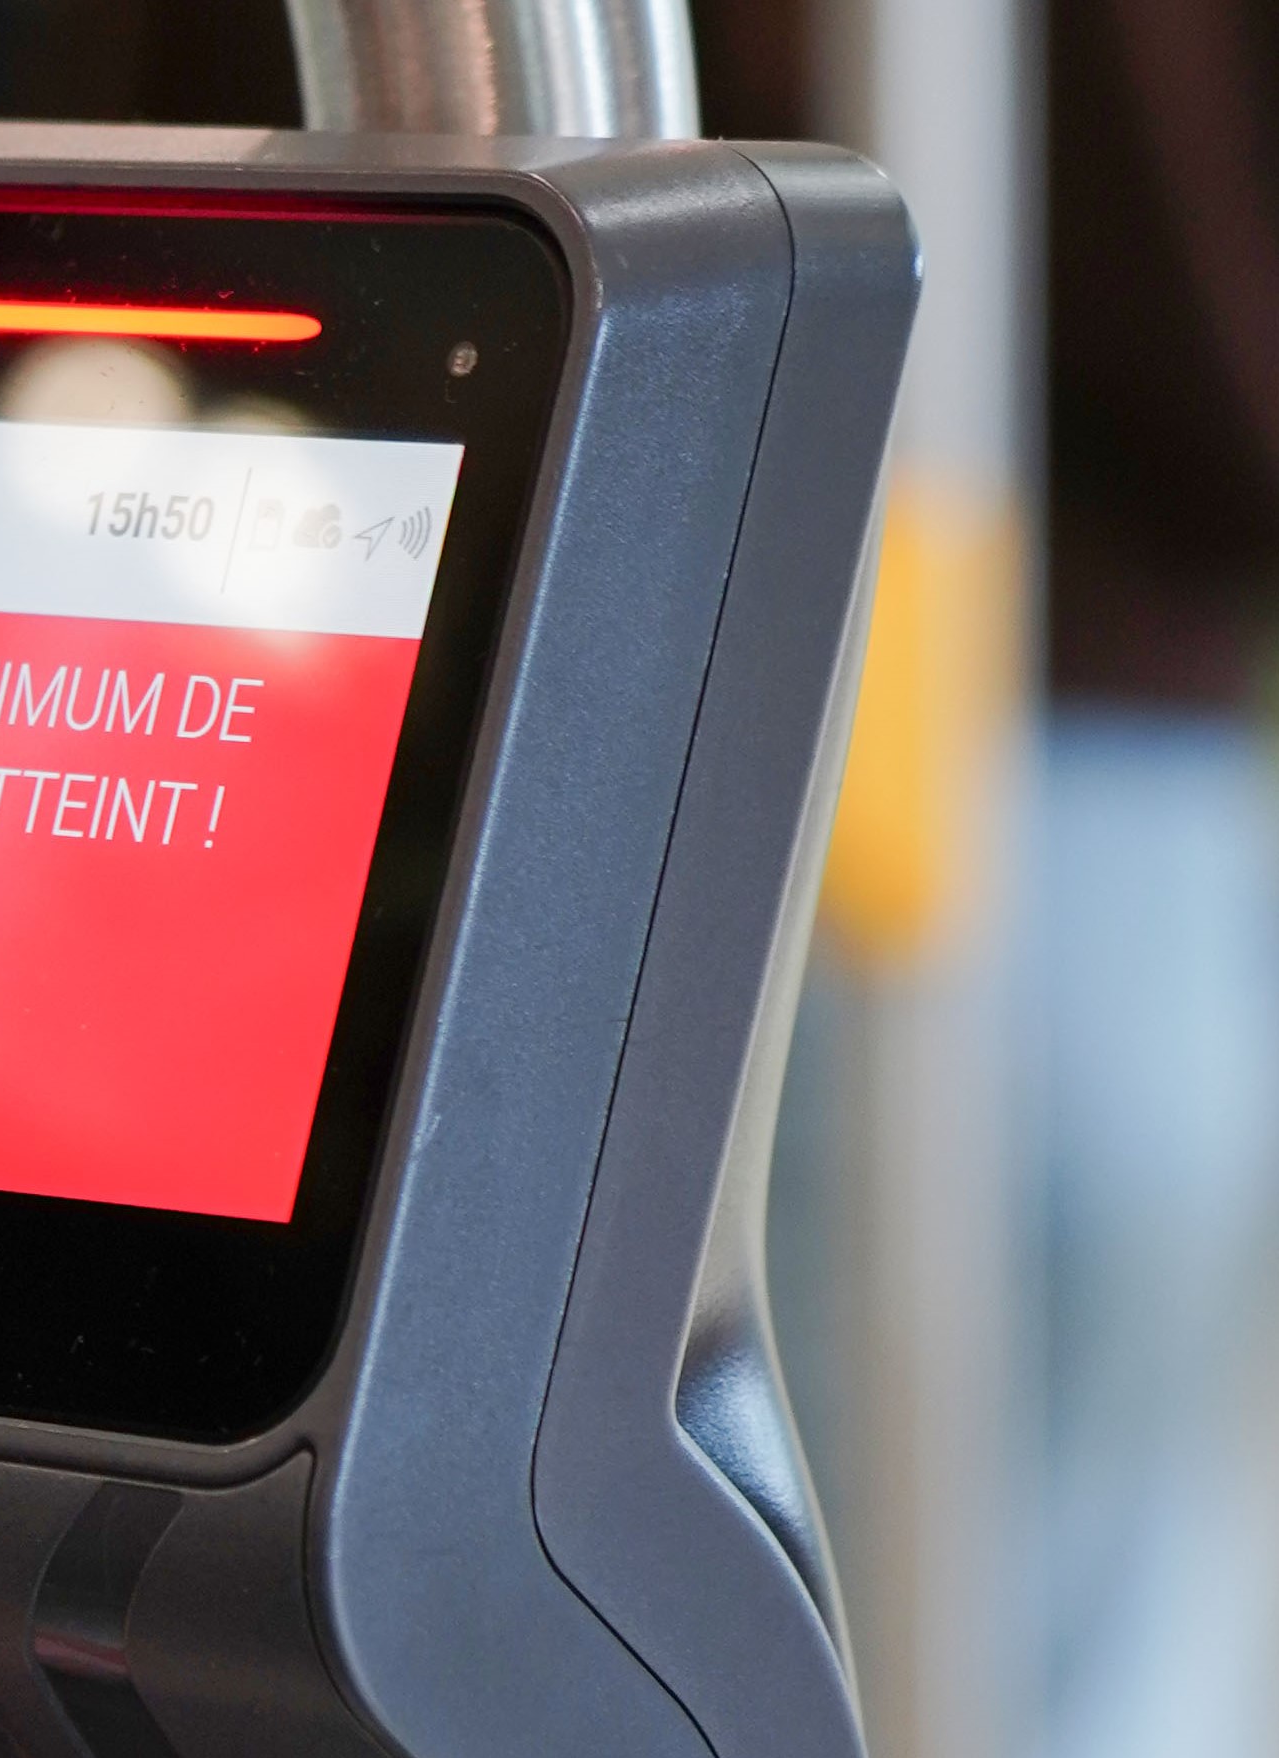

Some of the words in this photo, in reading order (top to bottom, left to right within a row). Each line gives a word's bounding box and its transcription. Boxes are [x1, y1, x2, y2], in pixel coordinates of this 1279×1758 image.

[87, 491, 215, 542] 15h50
[176, 674, 265, 743] DE
[203, 785, 225, 849] !
